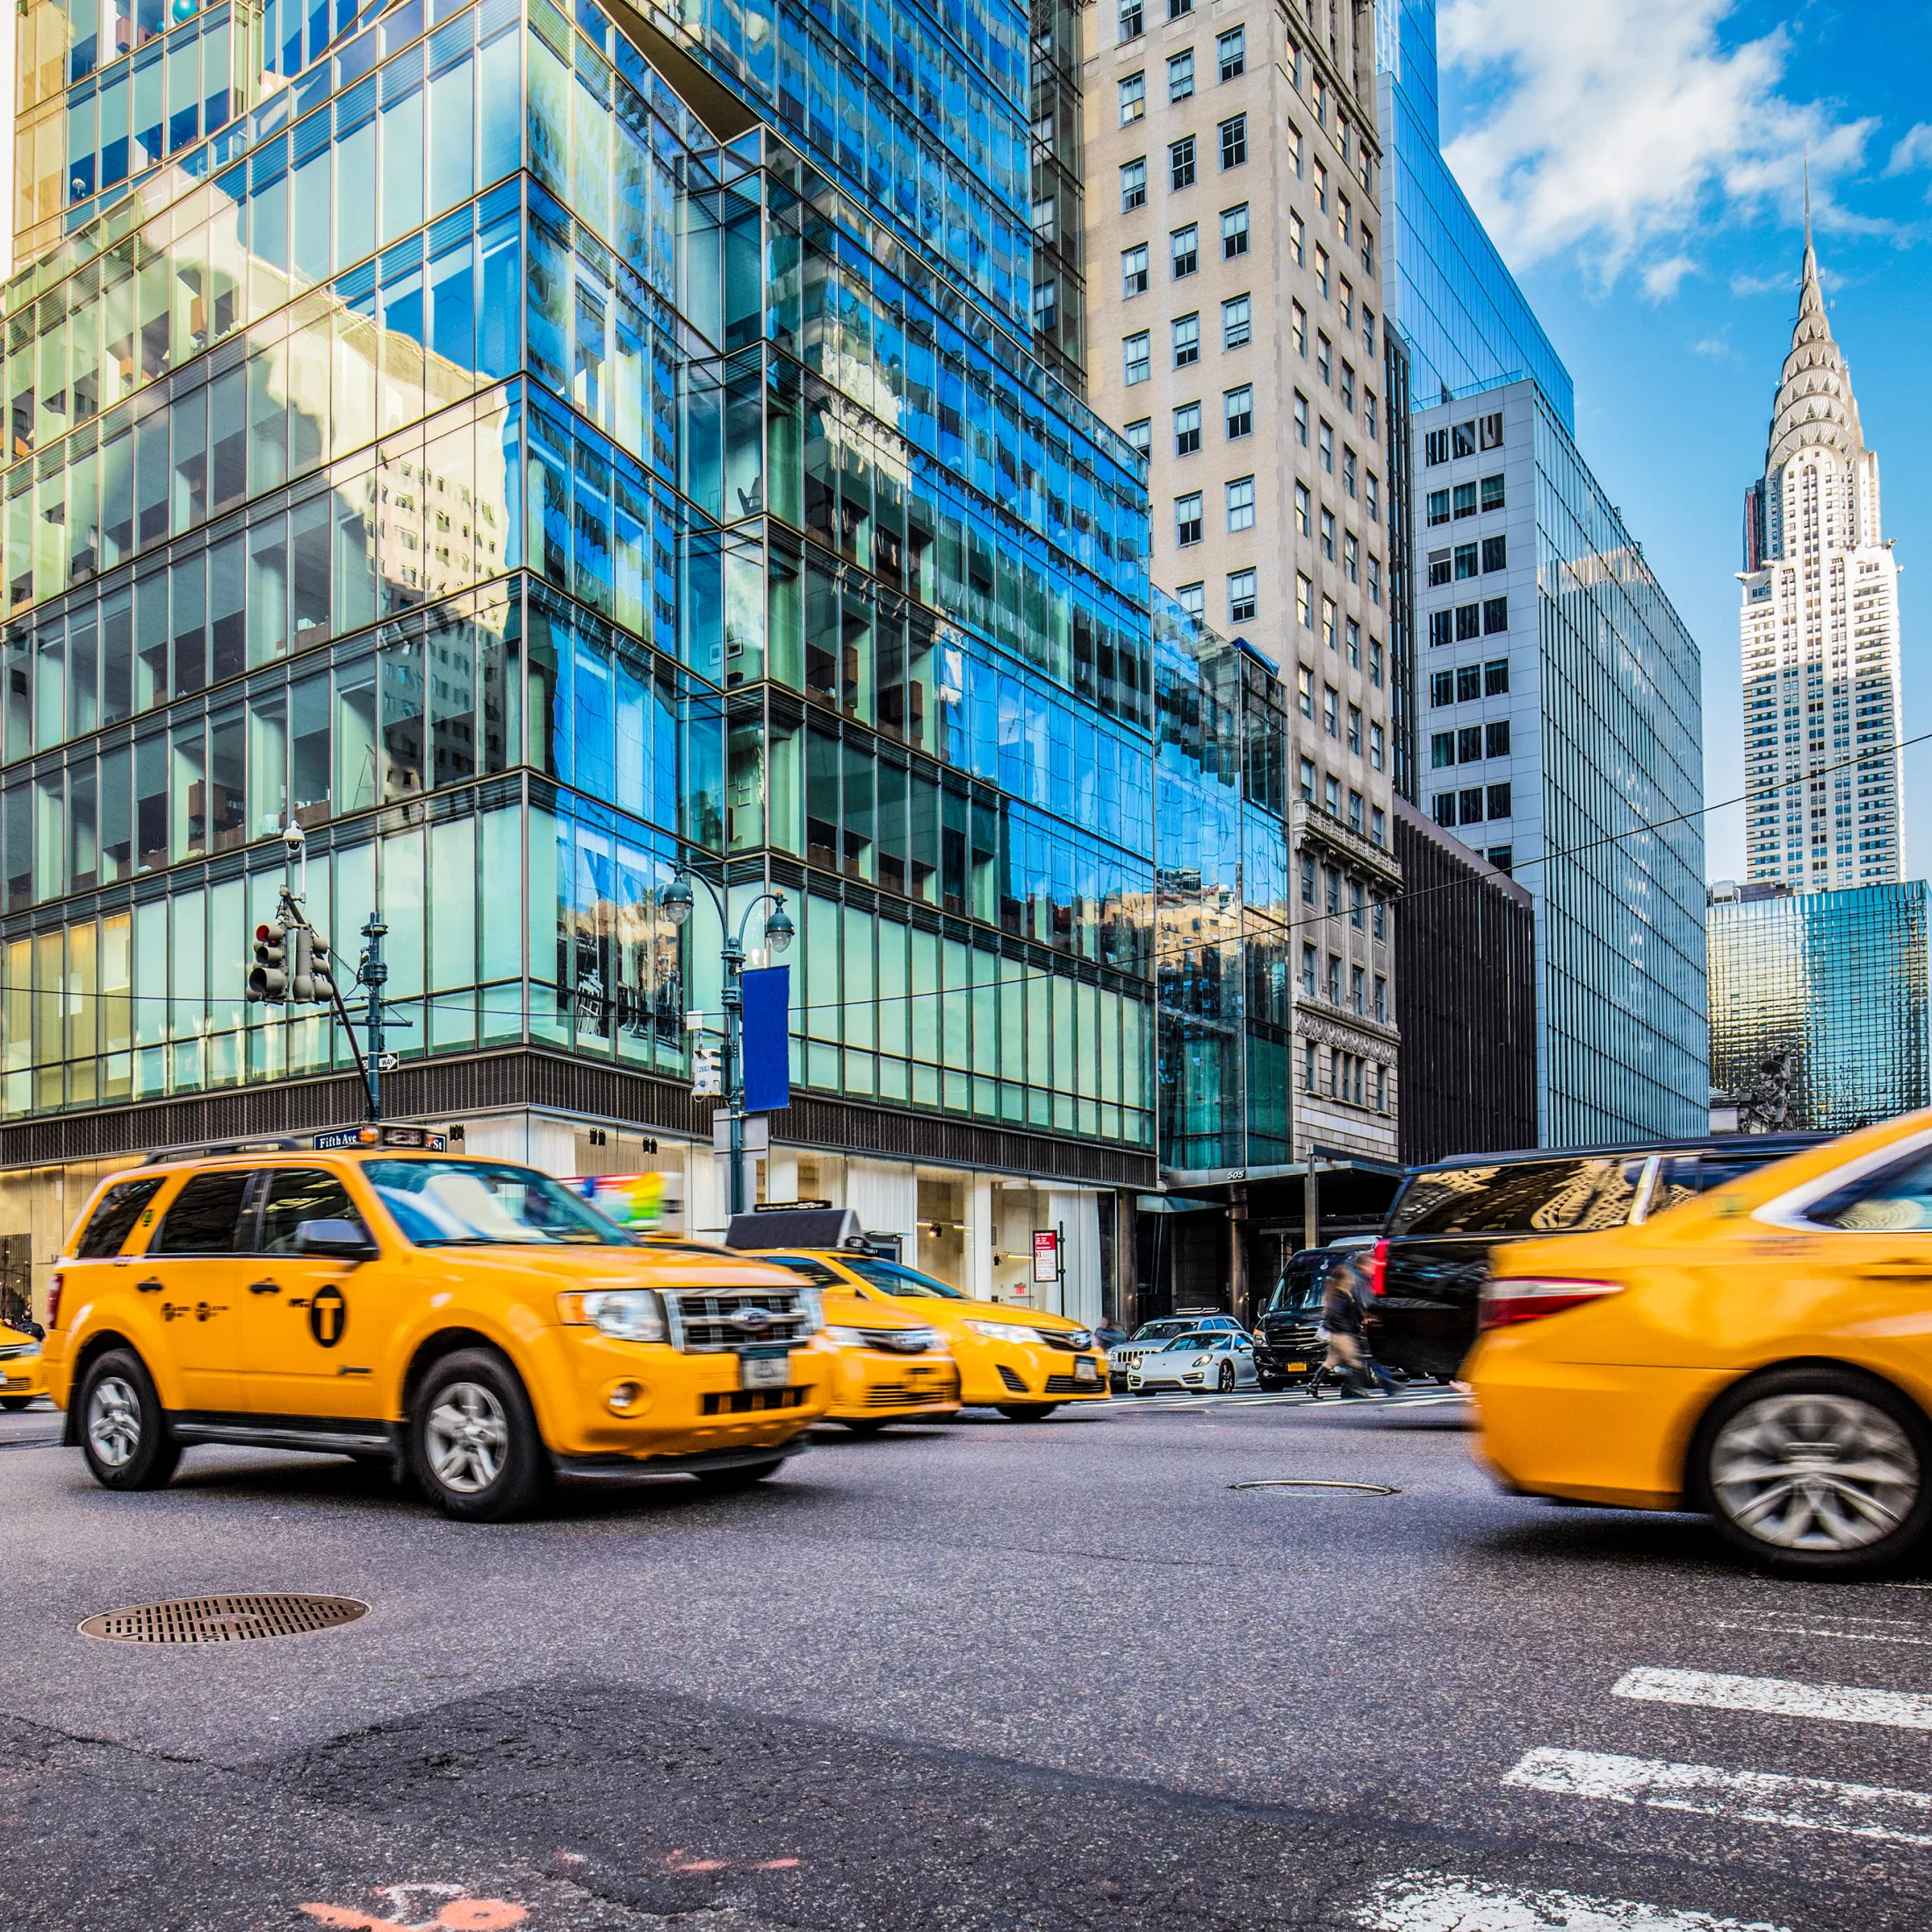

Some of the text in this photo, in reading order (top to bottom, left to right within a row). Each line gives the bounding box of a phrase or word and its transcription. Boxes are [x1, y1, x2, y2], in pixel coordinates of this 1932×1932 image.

[320, 1134, 357, 1149] Fifth Ave
[433, 1139, 443, 1150] St
[1227, 1170, 1244, 1179] 505
[314, 1297, 342, 1339] T
